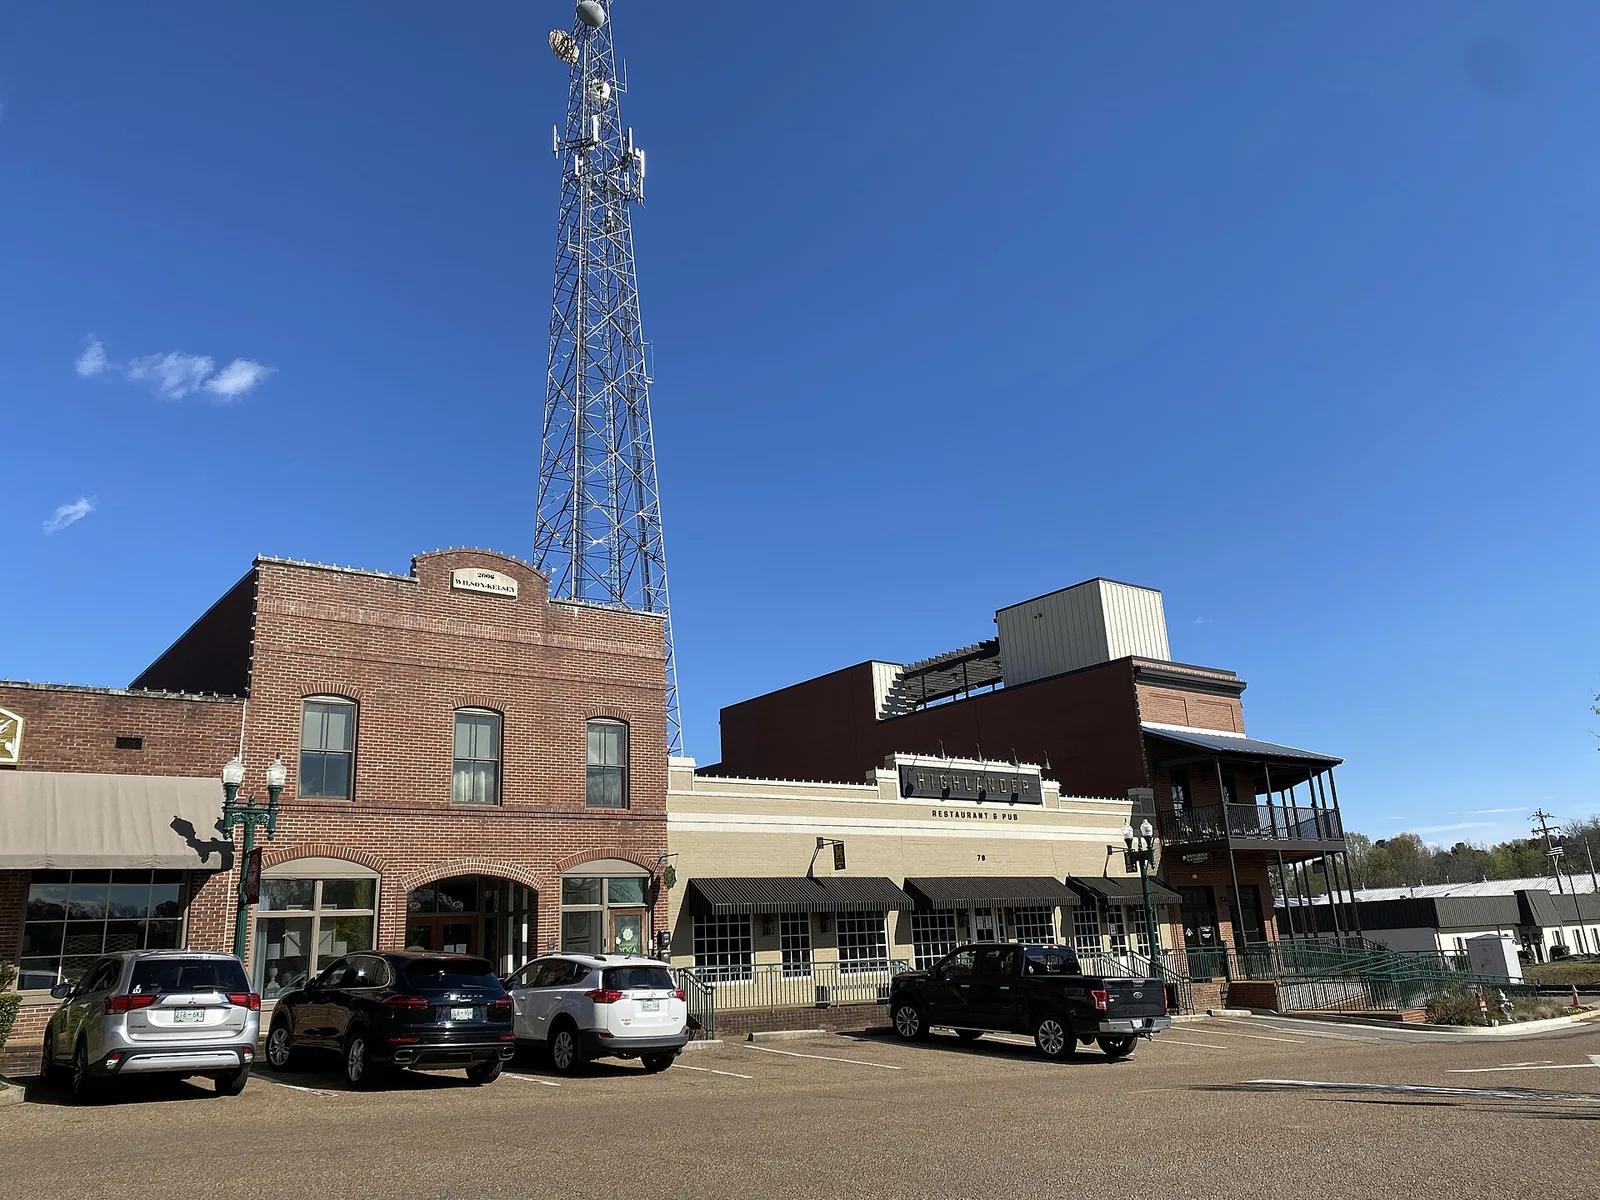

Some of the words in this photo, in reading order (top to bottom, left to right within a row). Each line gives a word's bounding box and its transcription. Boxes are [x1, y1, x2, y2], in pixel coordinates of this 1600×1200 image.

[477, 572, 495, 580] 2006
[455, 578, 515, 593] WILSON-KELSEY
[916, 772, 1029, 795] HIGHLANDER
[931, 810, 989, 820] RESTAURANT
[1002, 813, 1018, 821] PUB
[976, 854, 986, 862] 78
